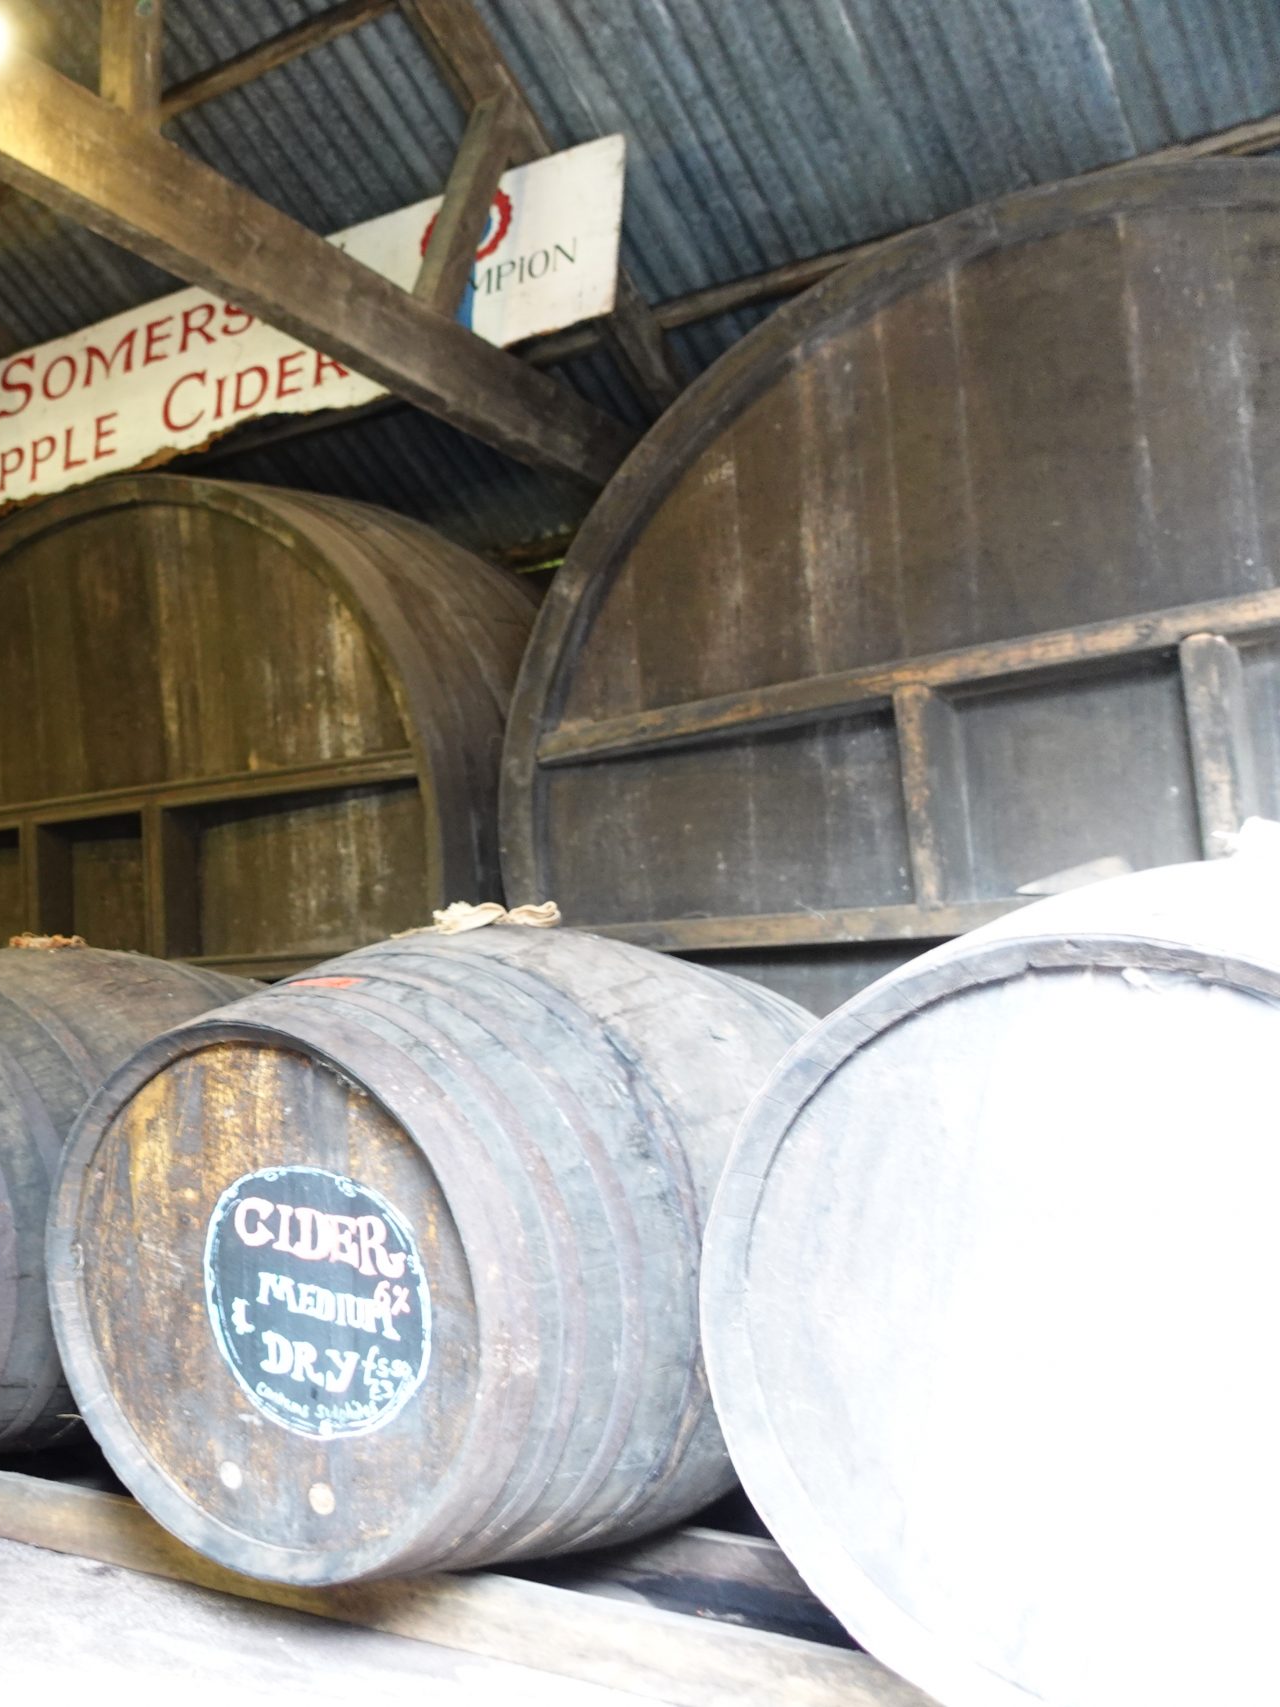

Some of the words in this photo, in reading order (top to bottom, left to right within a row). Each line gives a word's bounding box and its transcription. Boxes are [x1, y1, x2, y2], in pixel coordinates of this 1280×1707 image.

[469, 236, 578, 296] MPION
[234, 1196, 407, 1278] CIDER
[256, 1271, 401, 1342] MEDIUM
[374, 1279, 410, 1317] 6%
